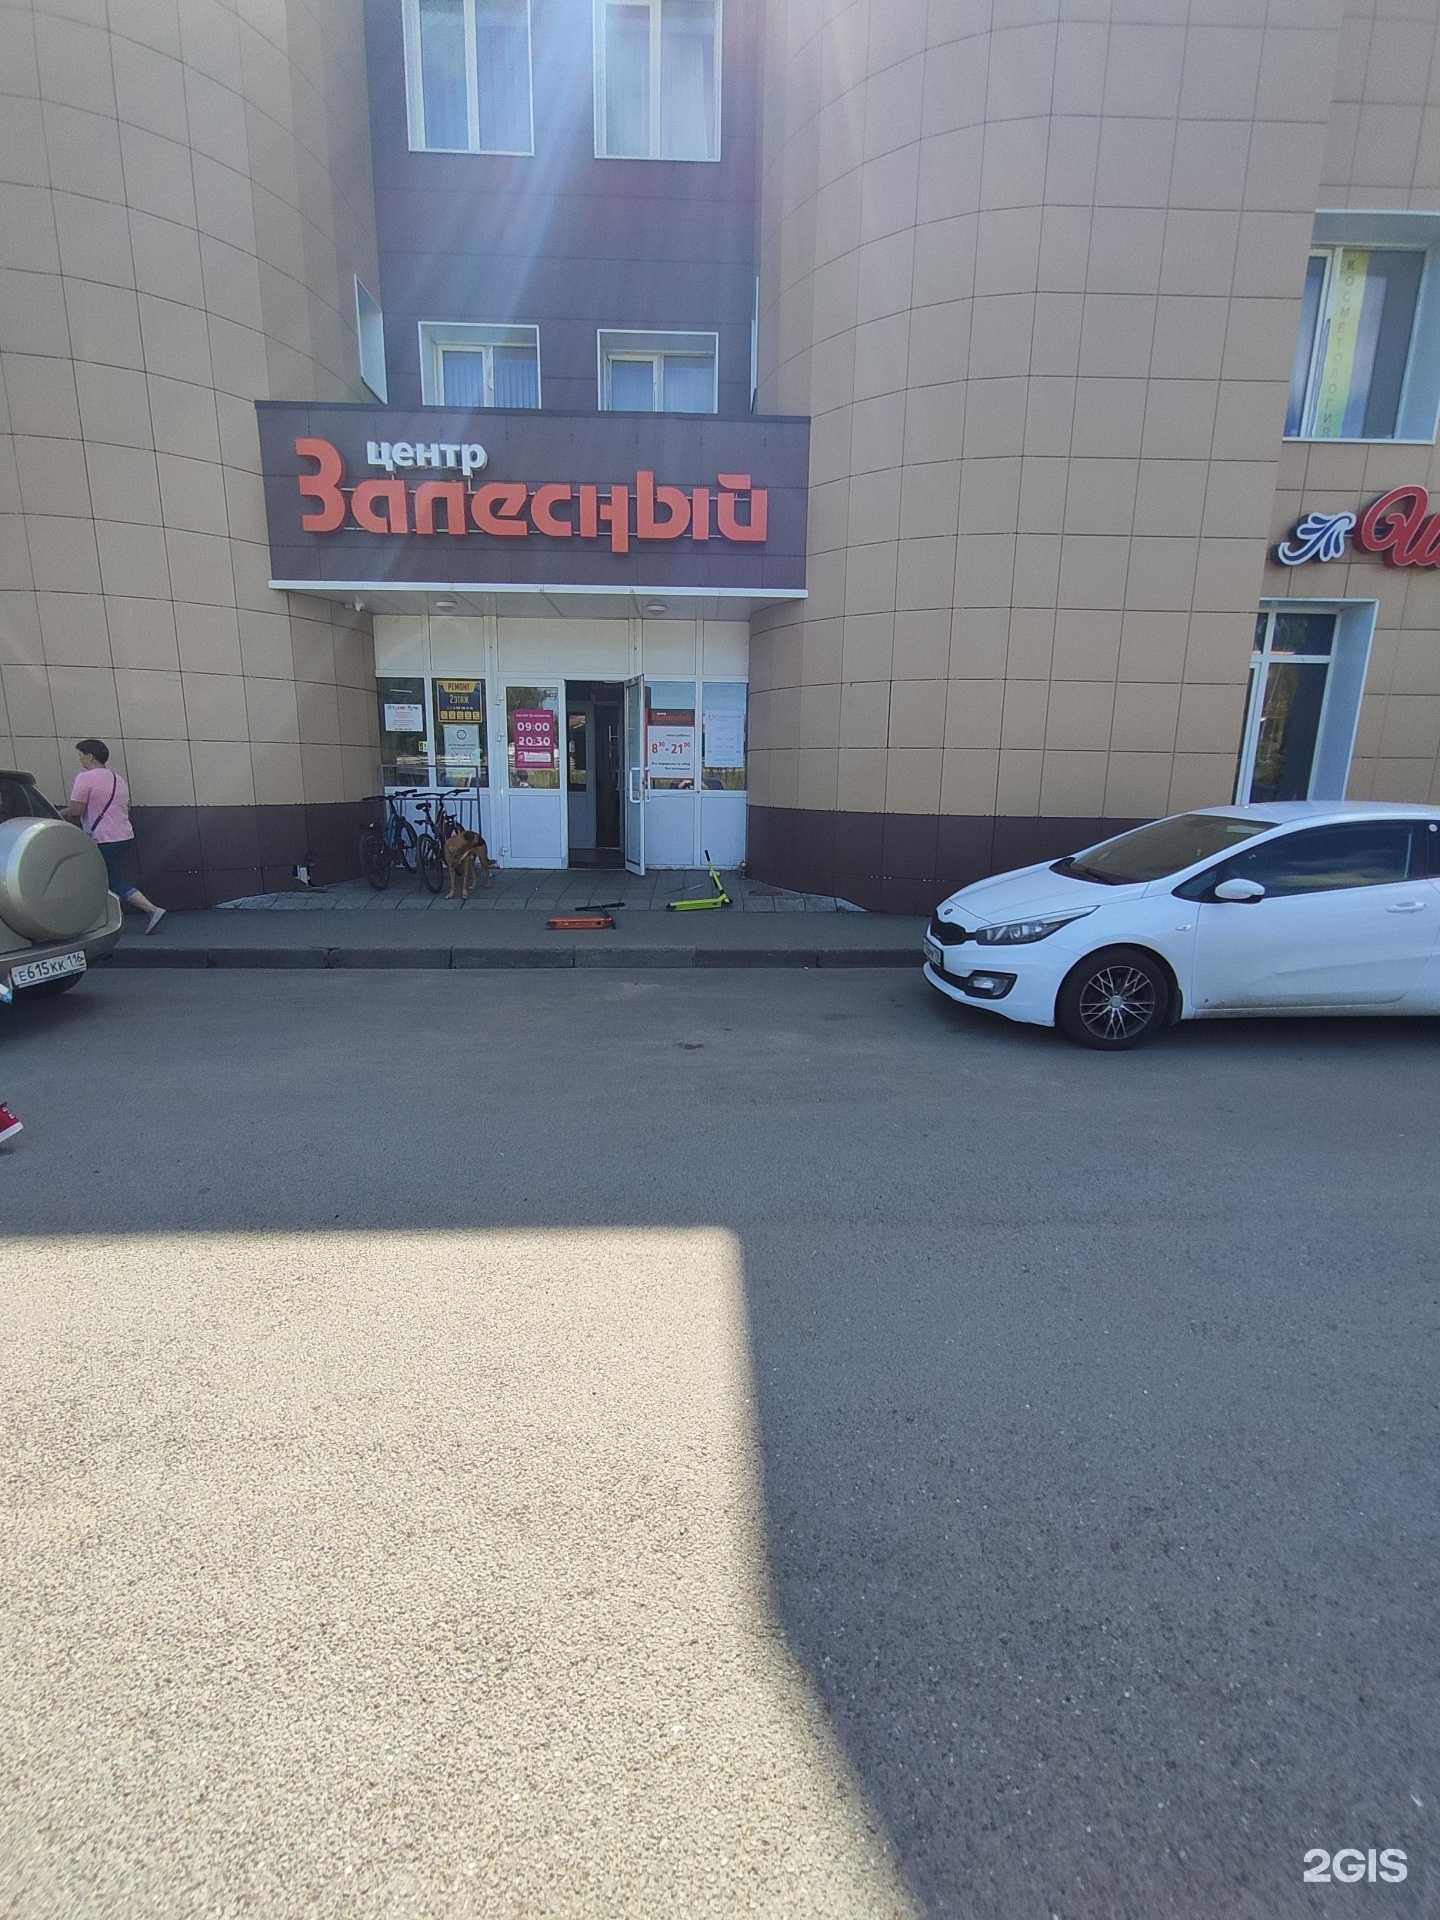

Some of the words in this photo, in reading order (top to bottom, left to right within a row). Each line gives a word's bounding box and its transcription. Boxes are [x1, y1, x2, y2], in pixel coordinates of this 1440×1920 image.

[366, 439, 489, 477] центр
[516, 721, 551, 732] 09:00
[518, 736, 551, 746] 20:30
